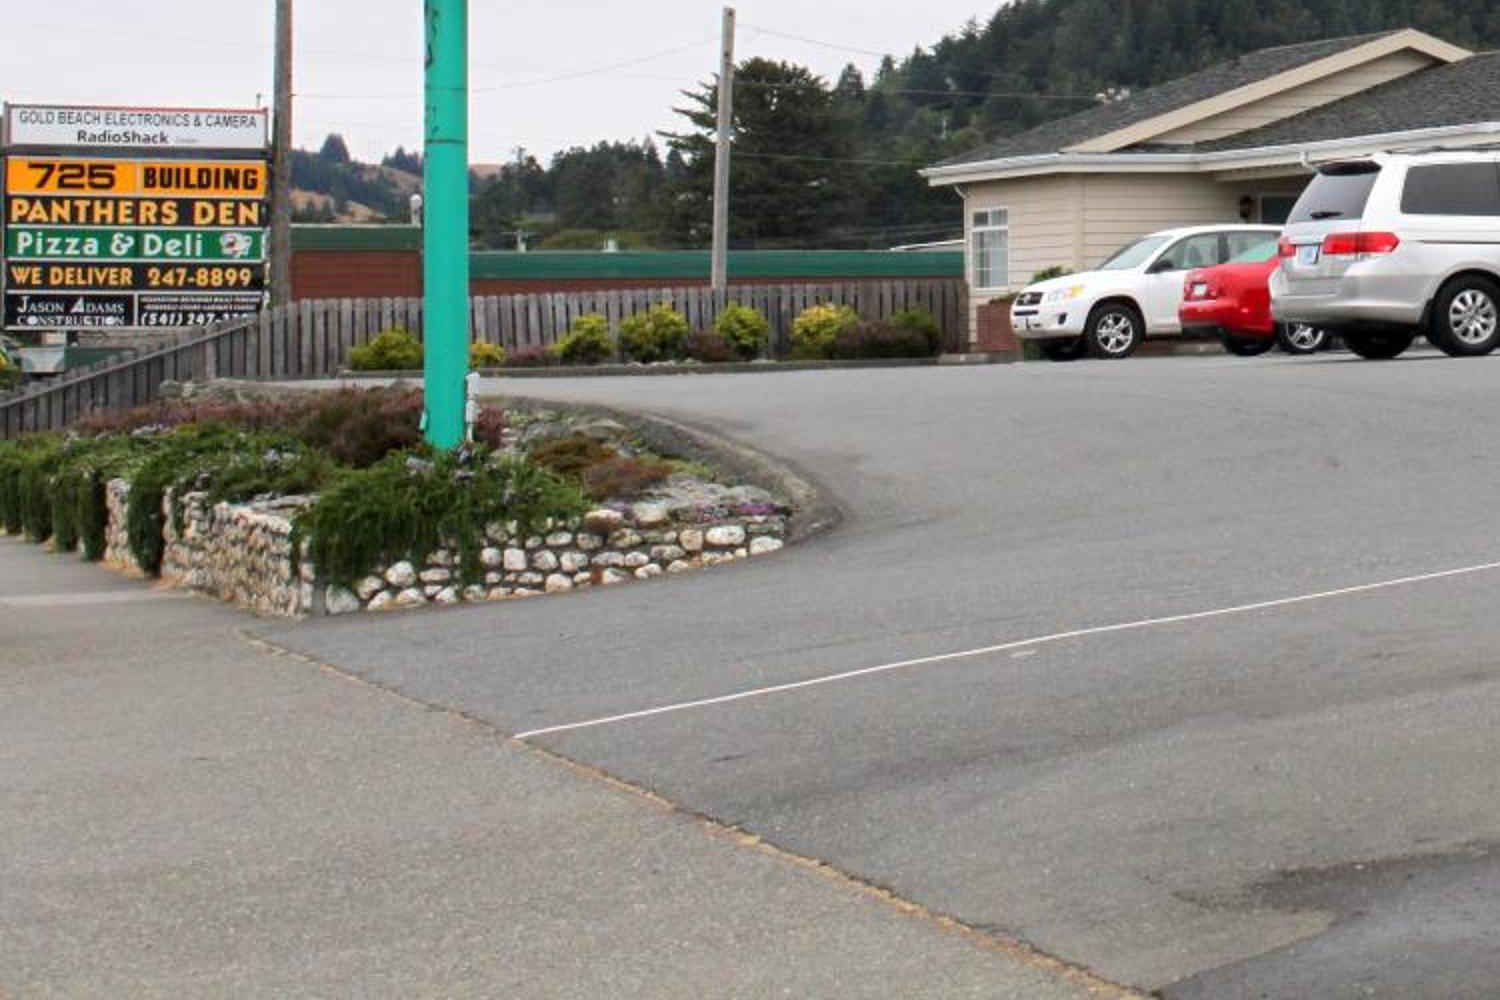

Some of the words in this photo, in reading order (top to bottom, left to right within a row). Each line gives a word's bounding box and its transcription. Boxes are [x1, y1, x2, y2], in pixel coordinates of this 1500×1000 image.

[19, 110, 55, 125] GOLD
[58, 111, 101, 125] BEACH
[104, 112, 191, 127] ELECTRONICS
[193, 114, 202, 128] &
[205, 115, 257, 129] CAMERA
[77, 130, 169, 145] RadioShack
[27, 163, 117, 189] 725
[143, 167, 259, 190] BUILDING
[11, 198, 179, 225] PANTHERS
[193, 201, 259, 225] DEN
[17, 231, 99, 256] Pizza
[110, 232, 135, 257] &
[143, 233, 203, 257] Deli
[11, 266, 43, 285] WE
[49, 266, 133, 286] DELIVER
[147, 267, 252, 287] 247-8899
[17, 295, 65, 313] JASON
[70, 296, 125, 314] ADAMS
[17, 315, 125, 326] CONSTRUCTION
[141, 311, 183, 327] (541)
